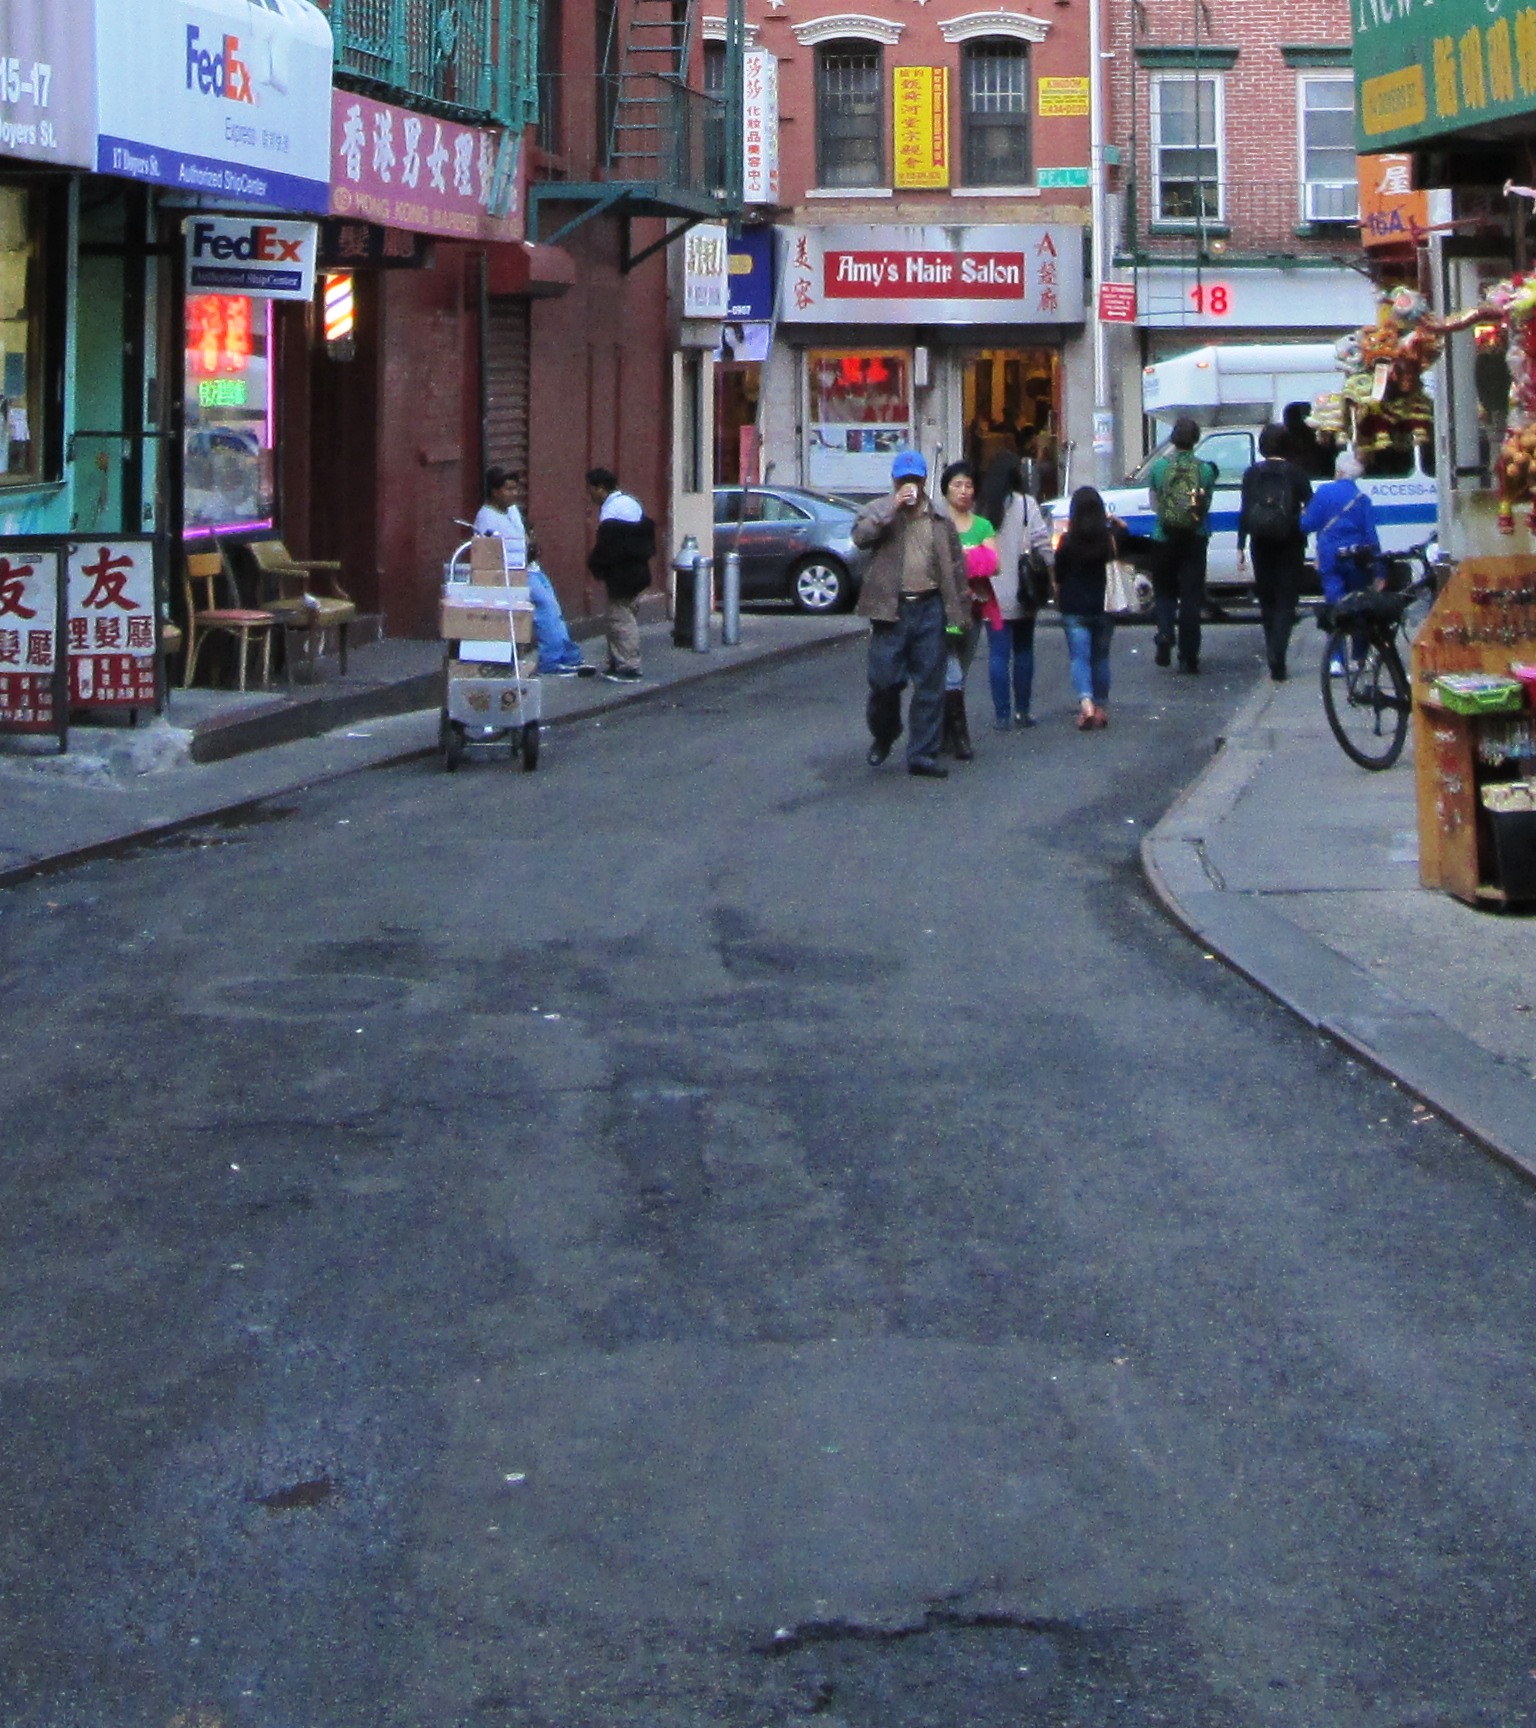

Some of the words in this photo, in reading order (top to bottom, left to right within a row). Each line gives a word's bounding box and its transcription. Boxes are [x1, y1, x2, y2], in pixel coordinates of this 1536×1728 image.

[186, 23, 255, 105] FedEx
[39, 119, 58, 150] St.
[178, 162, 223, 188] Authorized
[193, 223, 305, 262] FedEx
[836, 255, 899, 287] Amy's
[905, 257, 952, 284] Hair
[960, 258, 1019, 284] Salon
[1191, 285, 1228, 314] 18
[81, 547, 140, 611] 友
